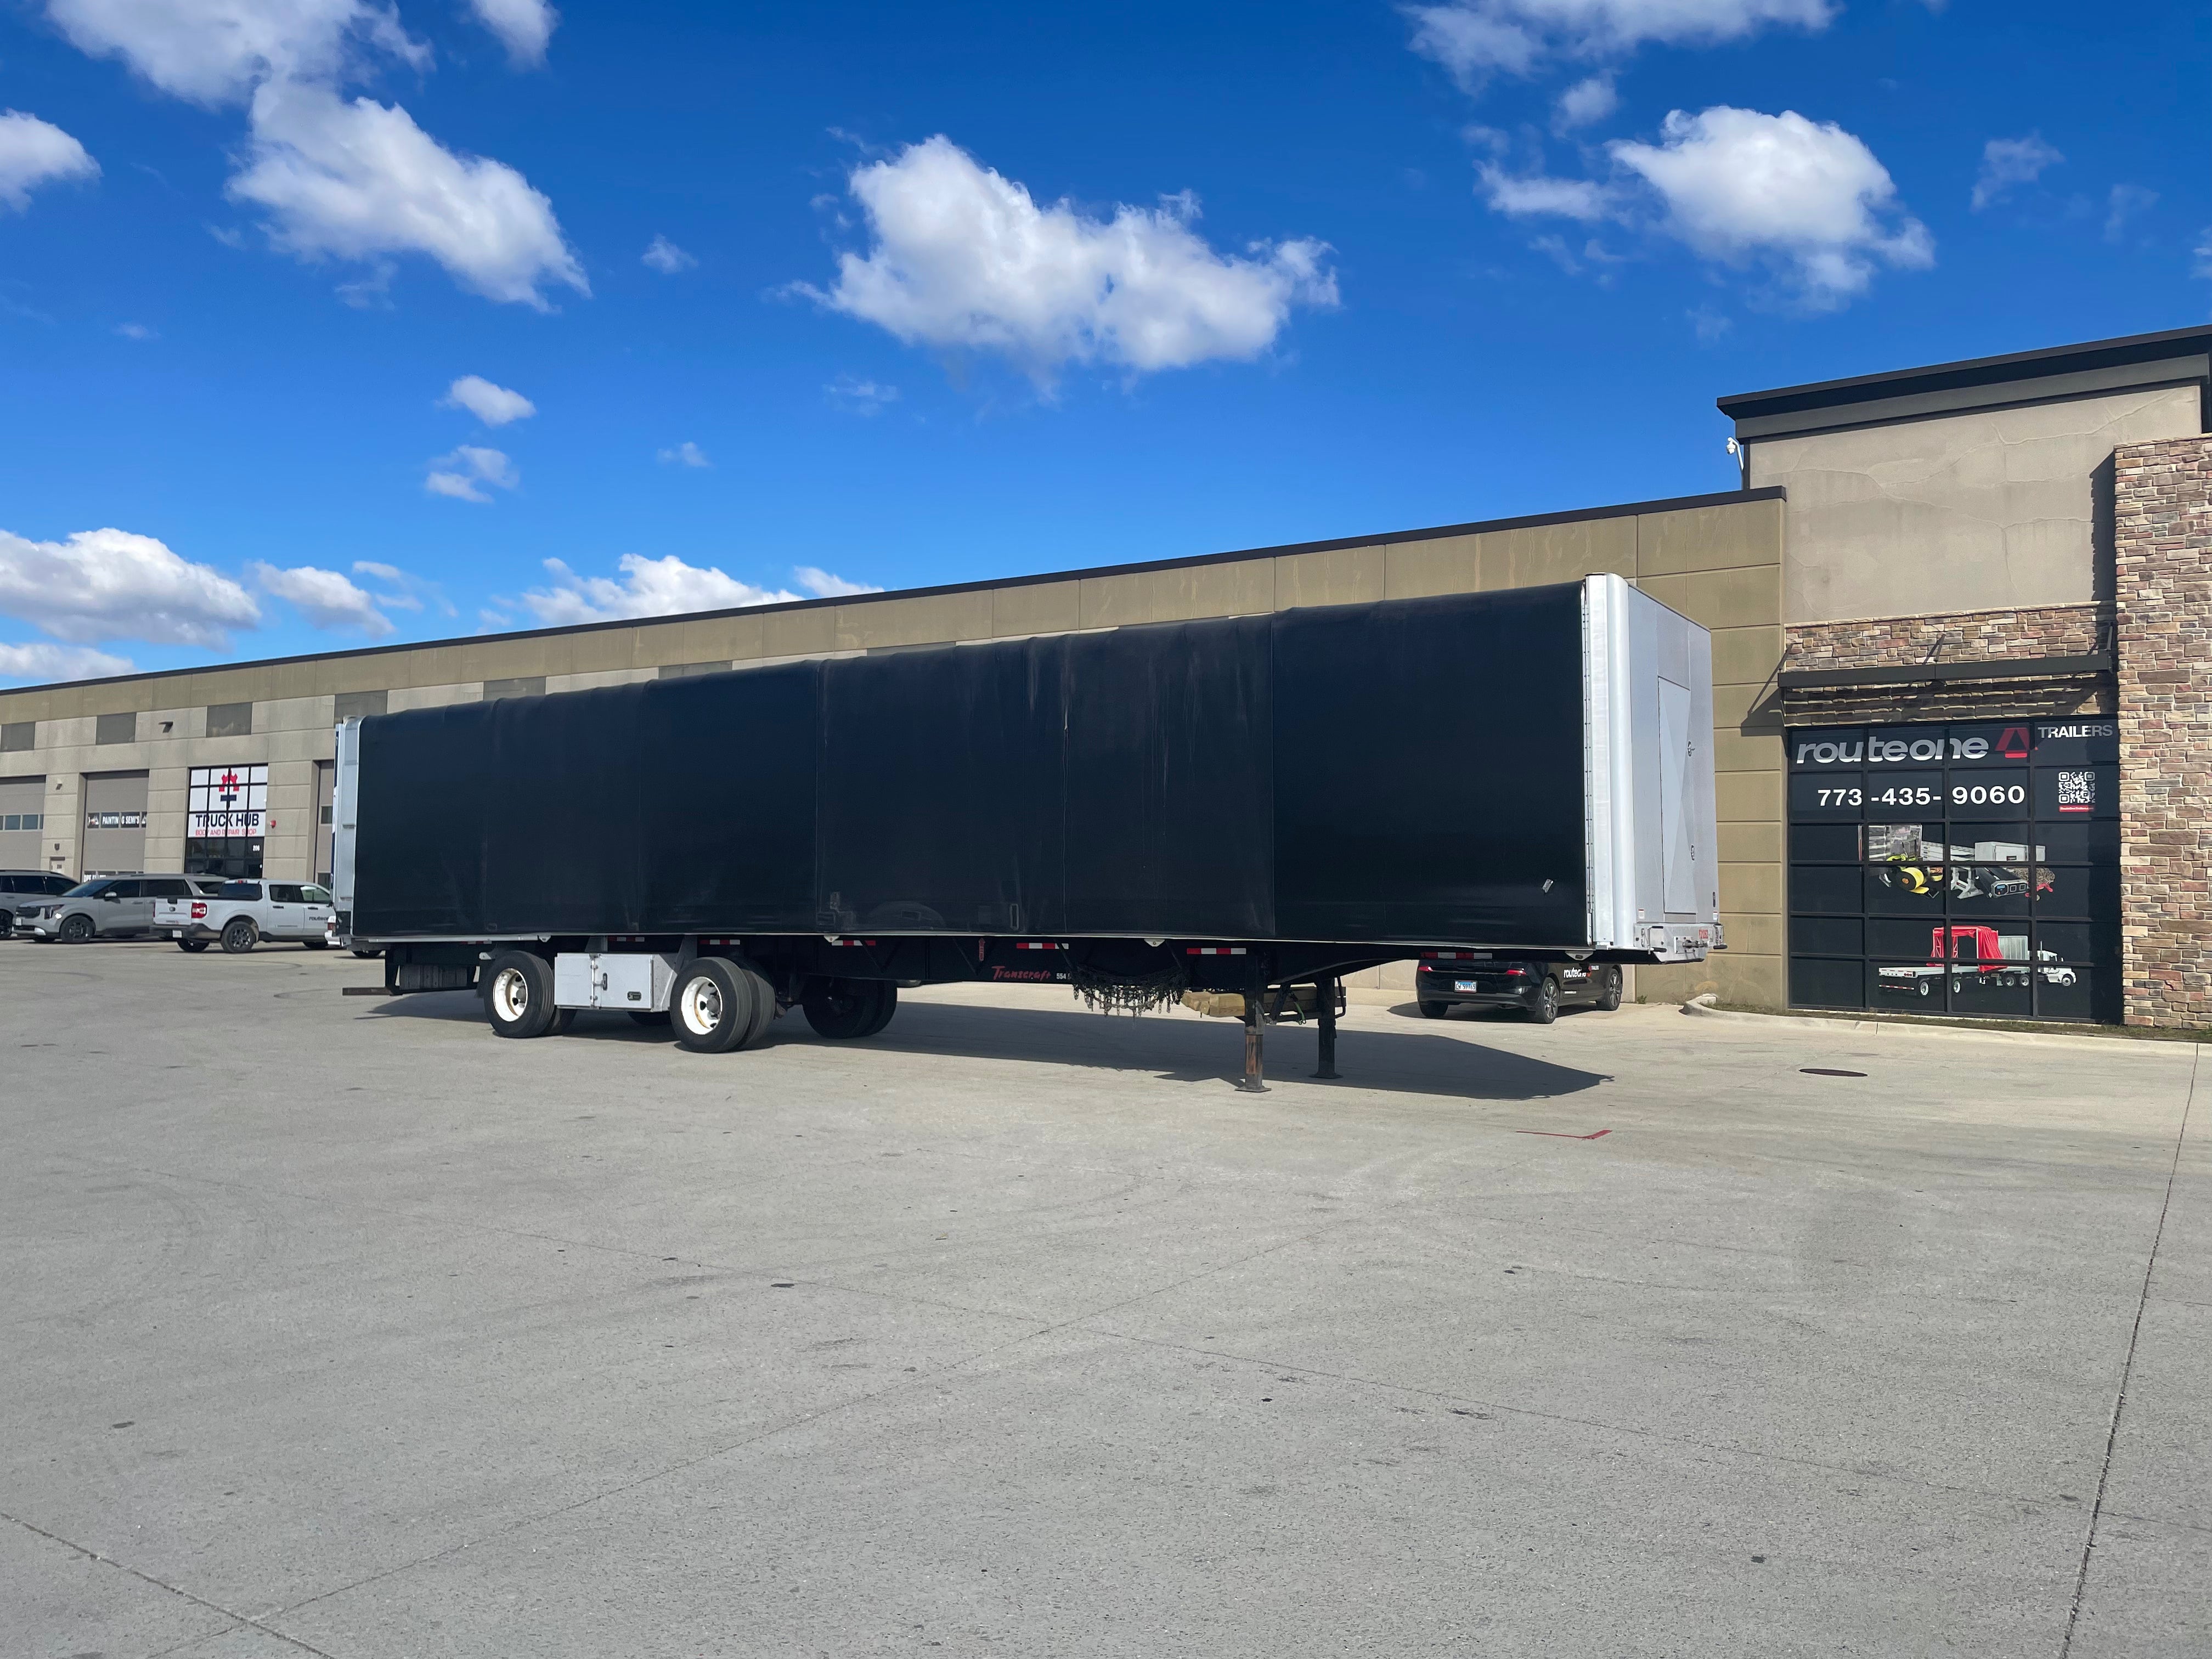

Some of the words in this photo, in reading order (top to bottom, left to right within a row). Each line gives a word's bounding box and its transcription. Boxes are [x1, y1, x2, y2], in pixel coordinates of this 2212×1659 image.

[2038, 724, 2113, 738] TRAILERS
[1796, 736, 1989, 764] routeone
[102, 816, 125, 825] PAINTING
[196, 813, 233, 827] TRUCK
[236, 812, 259, 827] HUB
[991, 966, 1051, 981] Transcraft
